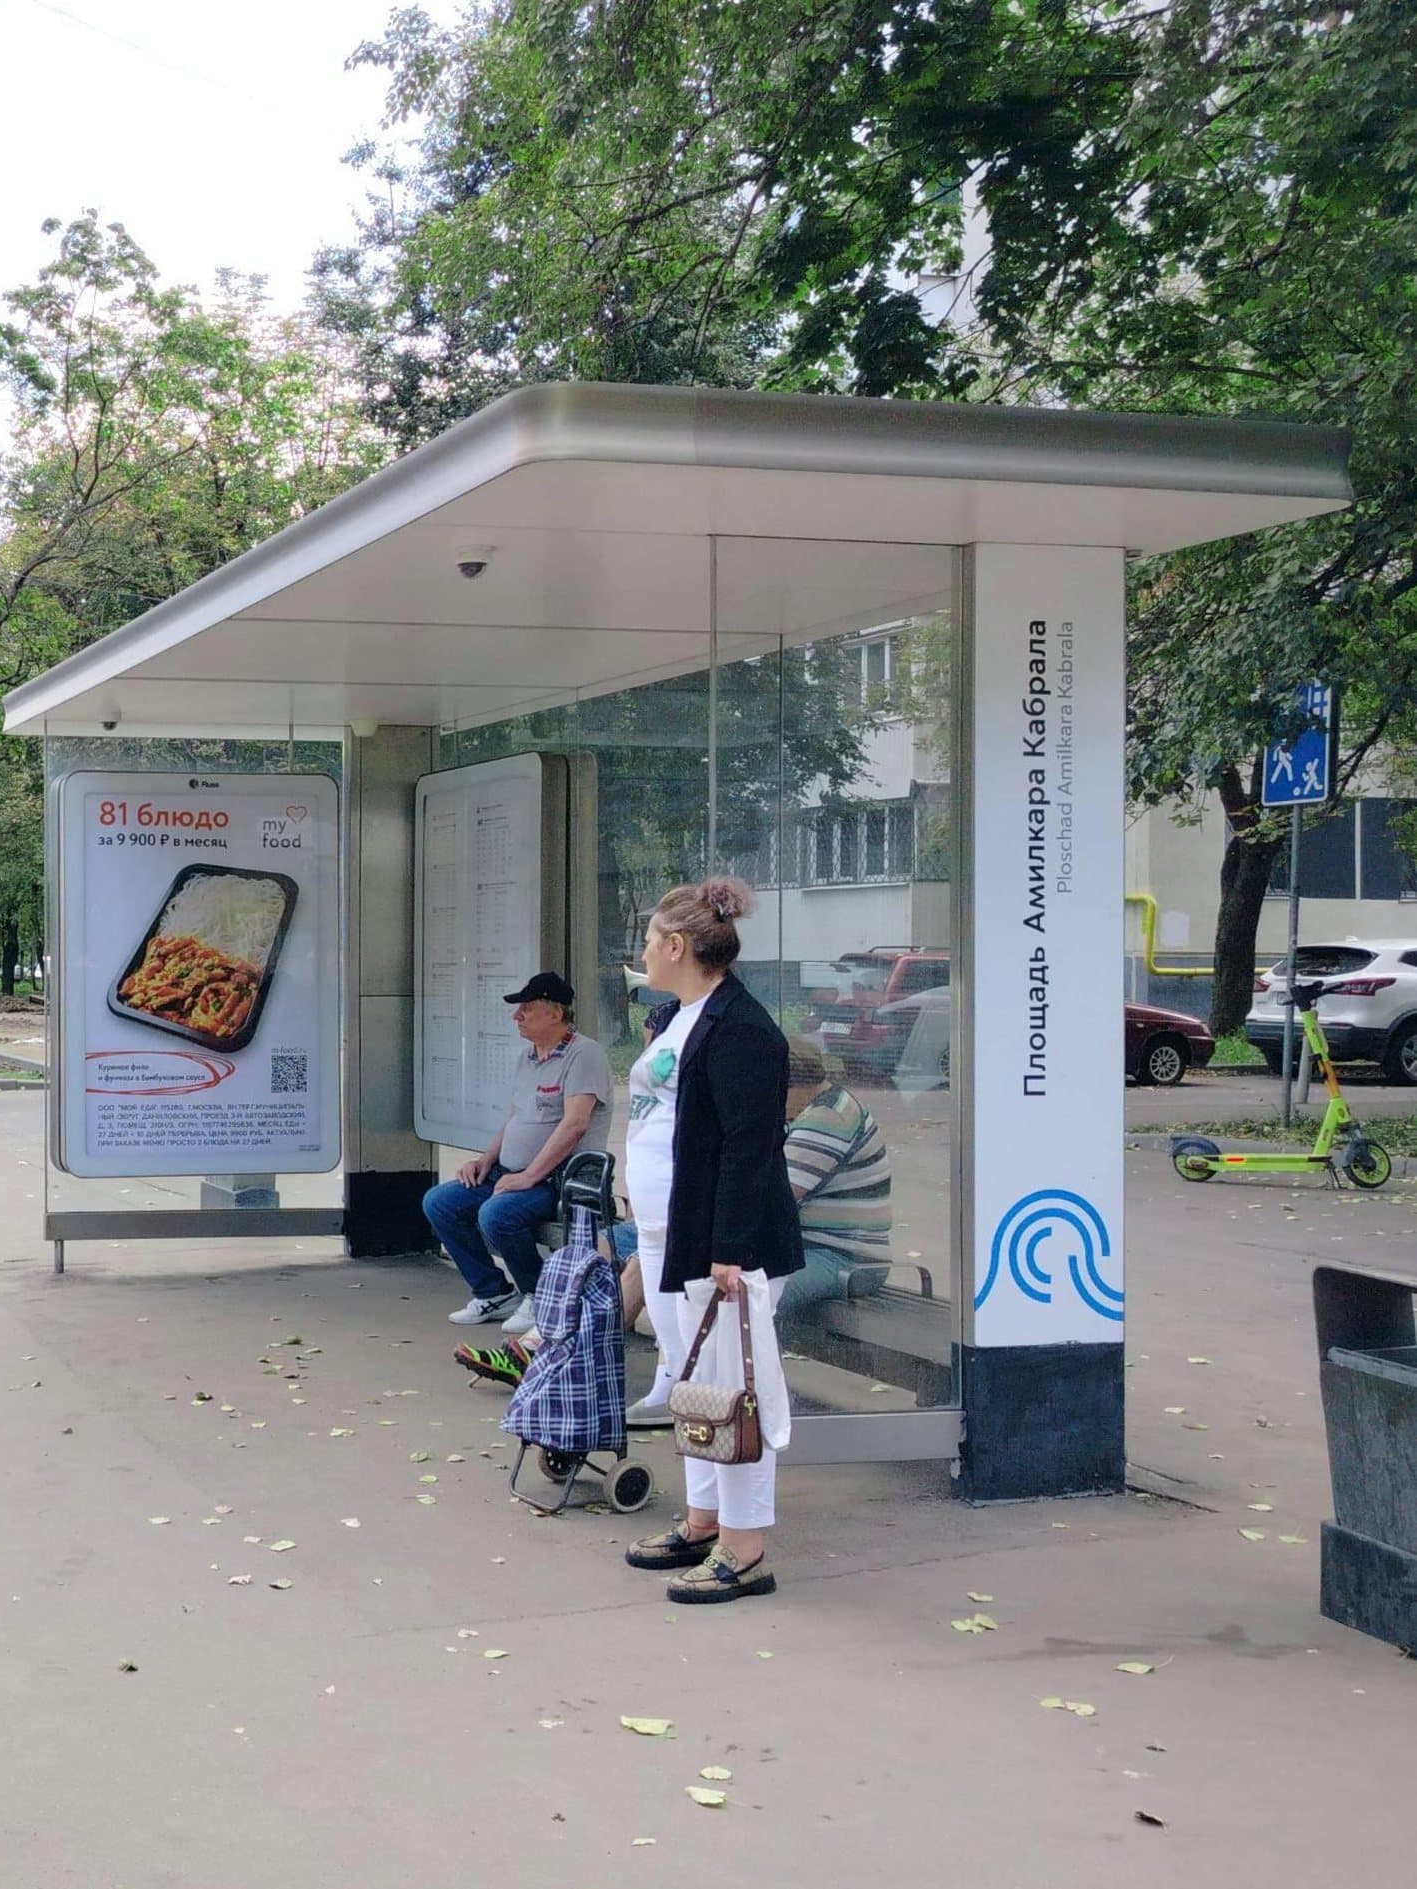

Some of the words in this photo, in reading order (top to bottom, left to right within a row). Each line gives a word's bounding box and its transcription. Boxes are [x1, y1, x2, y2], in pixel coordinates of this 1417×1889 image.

[1022, 619, 1051, 757] Кабрала
[1056, 621, 1073, 699] Kabrala
[1055, 704, 1073, 796] Amilkara
[98, 836, 113, 846] за
[116, 833, 126, 846] 9
[129, 833, 156, 846] 900
[173, 838, 181, 847] в
[185, 838, 228, 849] месяц
[99, 801, 128, 827] 81
[137, 803, 230, 831] блюдо
[263, 820, 287, 834] my
[263, 833, 302, 848] food
[1023, 768, 1051, 934] Амилкара
[1056, 802, 1073, 893] Ploschad
[1023, 946, 1049, 1096] Площадь
